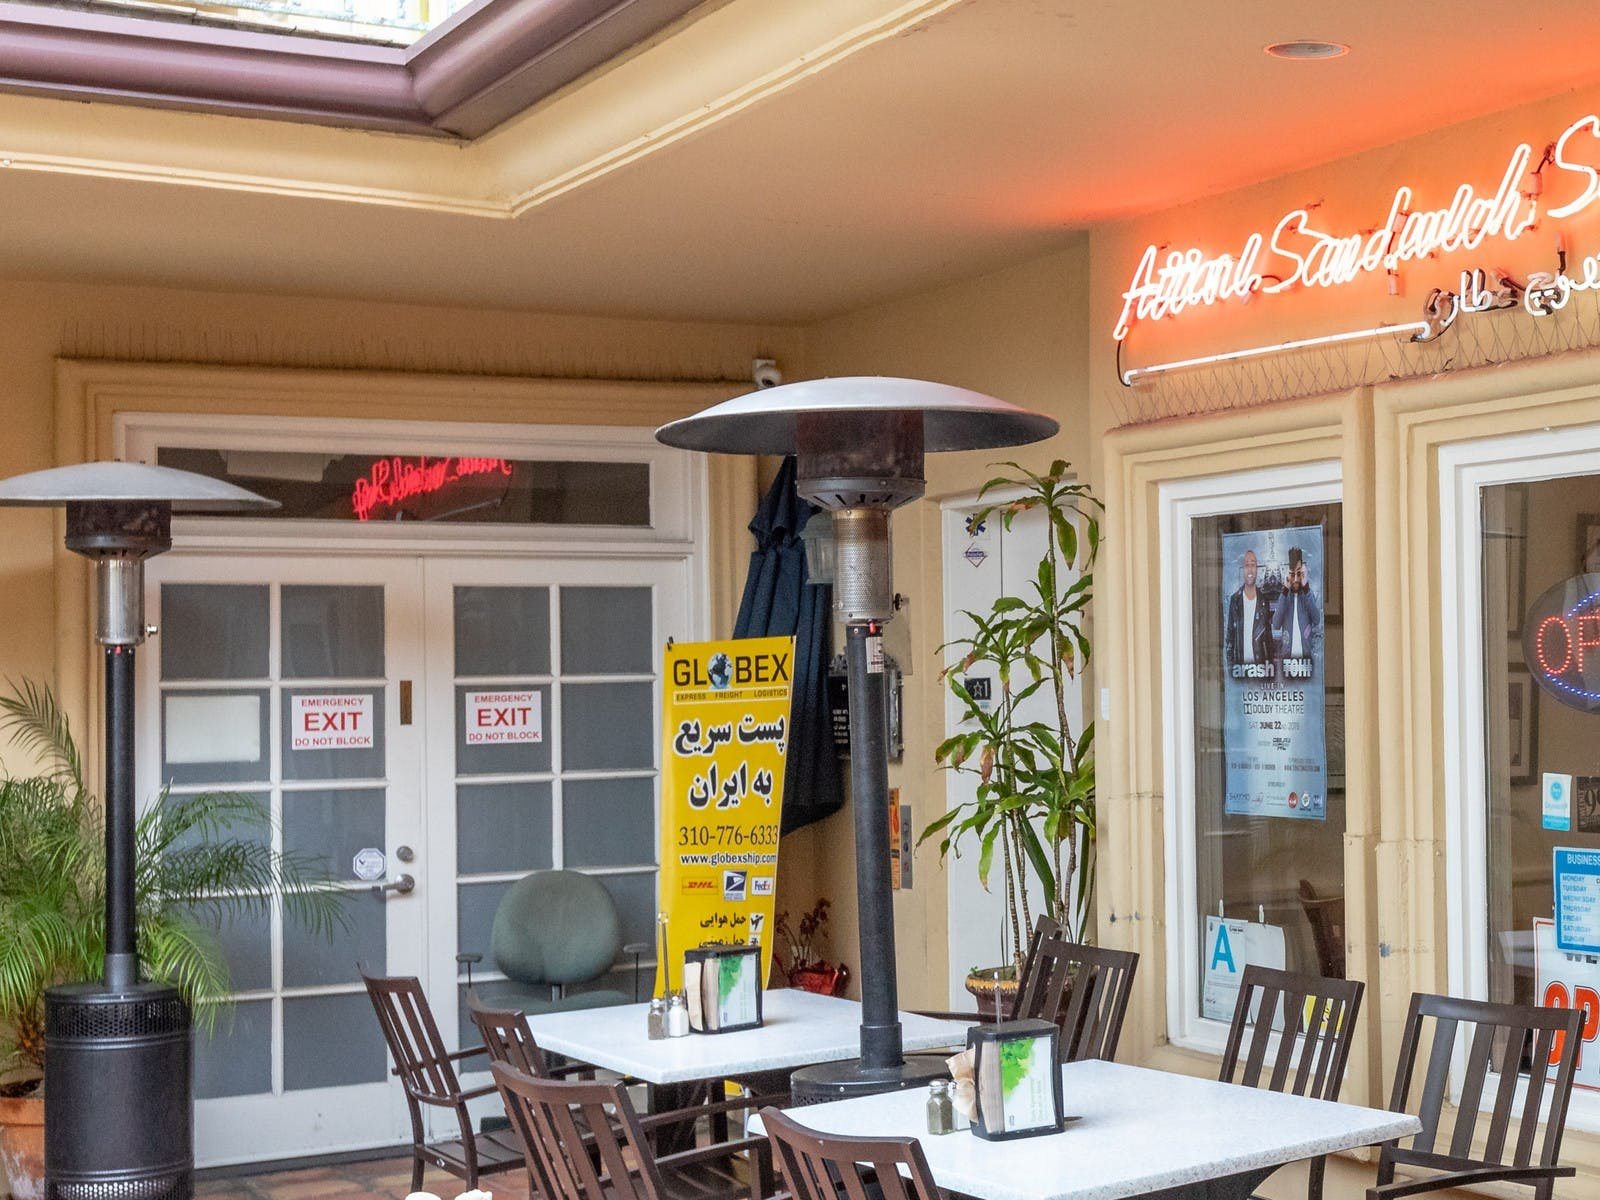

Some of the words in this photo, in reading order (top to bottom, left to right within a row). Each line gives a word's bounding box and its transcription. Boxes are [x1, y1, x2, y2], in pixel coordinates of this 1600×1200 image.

[1113, 232, 1262, 340] Attari
[1262, 143, 1537, 293] Sandwich
[673, 652, 788, 689] GLOBEX
[1232, 660, 1274, 678] arash
[302, 698, 364, 707] EMERGENCY
[475, 694, 532, 703] EMERGENCY
[676, 692, 706, 701] EXPRESS
[715, 691, 743, 699] FREIGHT
[754, 689, 788, 698] LOGISTICS
[1242, 692, 1258, 701] LOS
[1262, 692, 1304, 702] ANGELES
[478, 708, 532, 727] EXIT
[1253, 704, 1273, 714] DOLBY
[1276, 704, 1304, 714] THEATRE
[304, 712, 363, 732] EXIT
[295, 738, 310, 746] DO
[336, 736, 370, 745] BLOCK
[469, 733, 482, 741] DO
[486, 732, 504, 740] NOT
[507, 731, 539, 740] BLOCK
[674, 718, 731, 756] سریع
[738, 715, 785, 754] پست
[689, 761, 748, 810] ایران
[752, 768, 773, 806] به
[678, 825, 778, 846] 310-776-6333
[680, 853, 777, 866] www.globexship.com
[754, 880, 770, 890] FedEx
[730, 912, 746, 928] حمل
[1211, 924, 1236, 973] A
